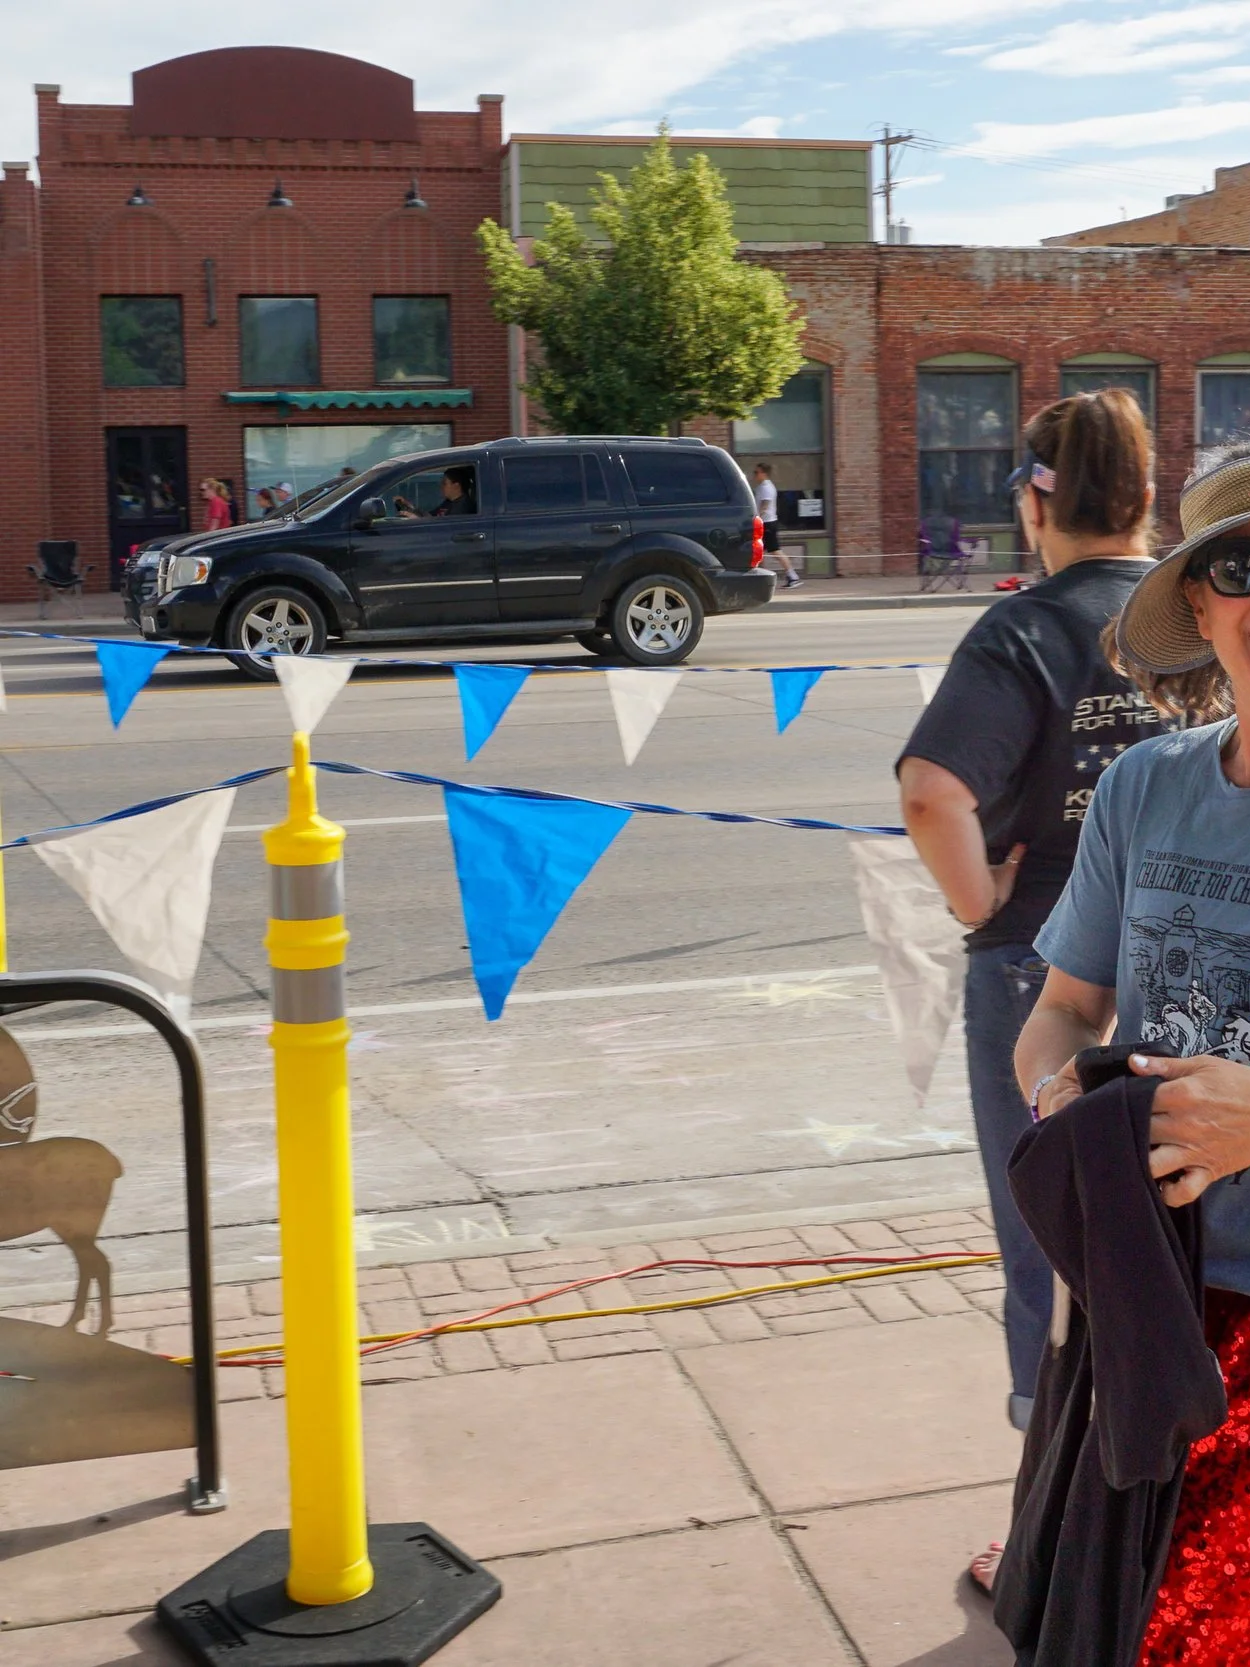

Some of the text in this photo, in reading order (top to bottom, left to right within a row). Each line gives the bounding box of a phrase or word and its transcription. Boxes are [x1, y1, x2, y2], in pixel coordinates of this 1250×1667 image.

[1070, 709, 1160, 732] FOR THE
[1181, 855, 1230, 872] COMMUNITY
[1136, 861, 1206, 896] CHALLENGE
[1200, 872, 1233, 901] FOR
